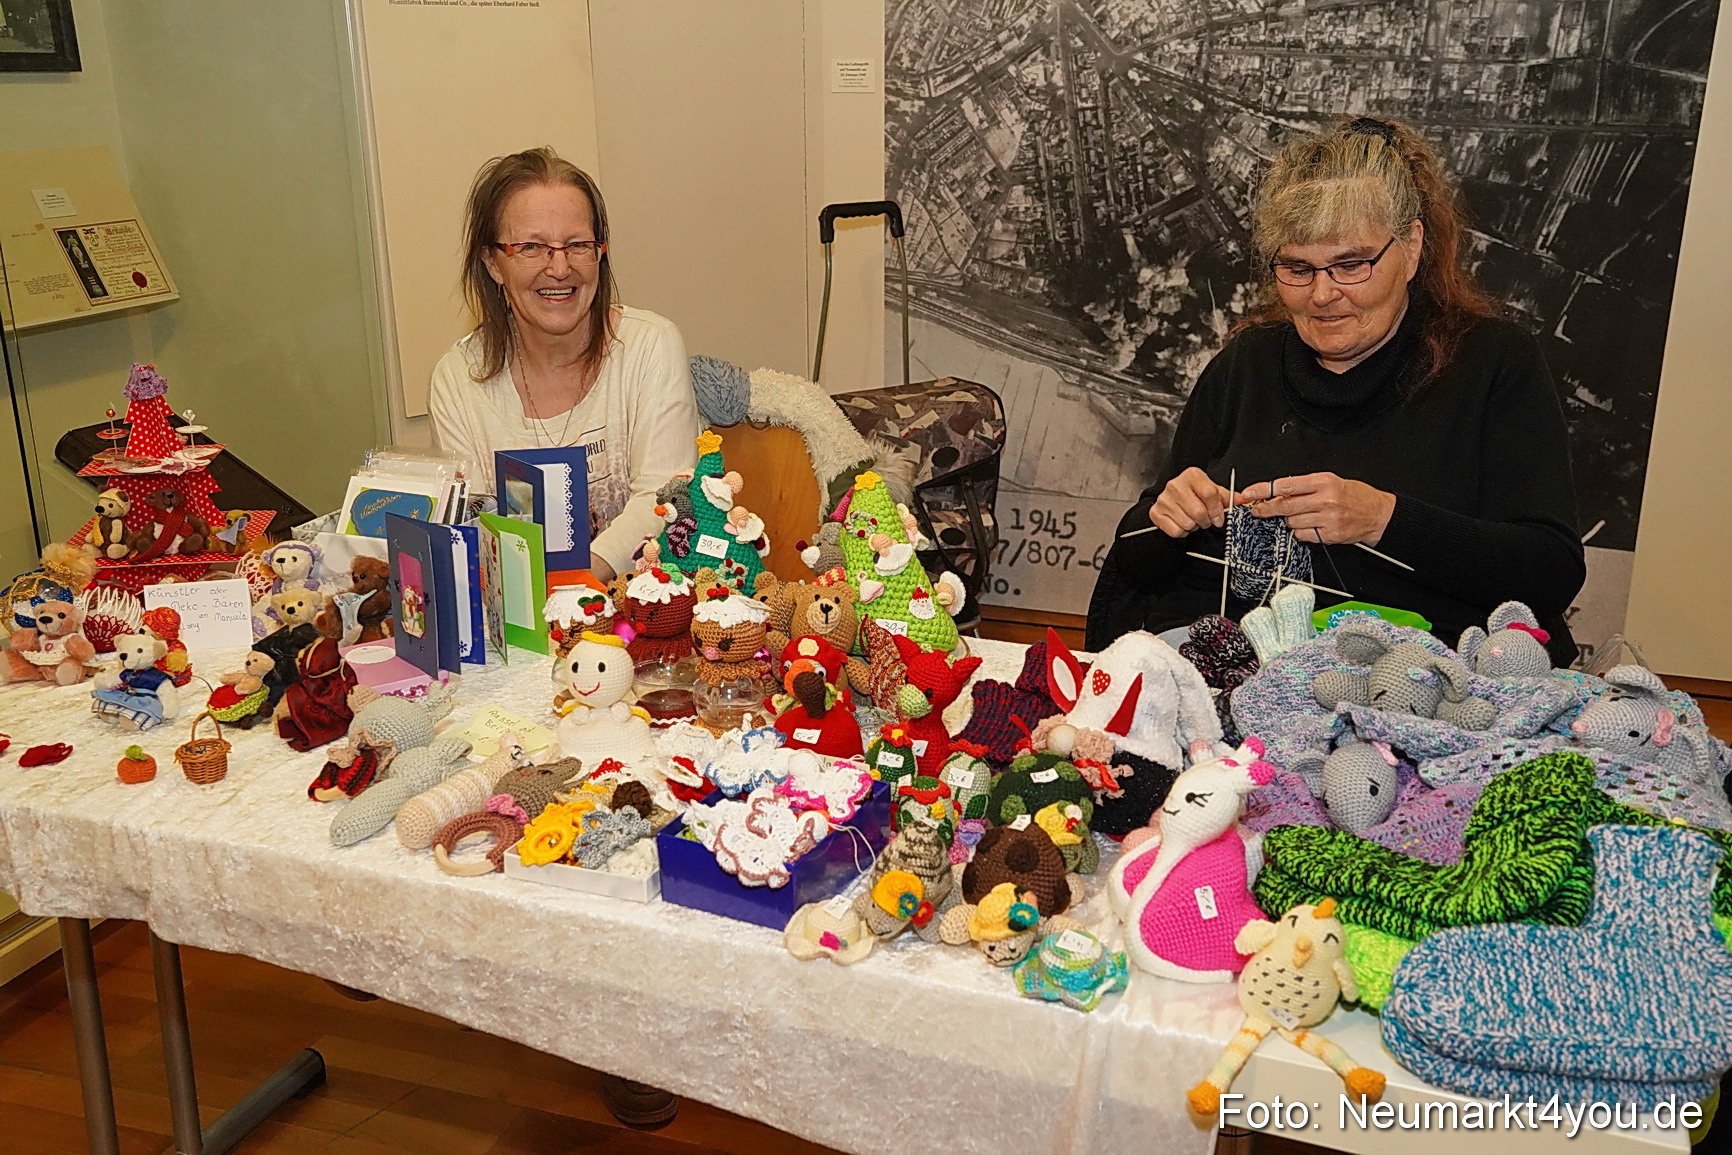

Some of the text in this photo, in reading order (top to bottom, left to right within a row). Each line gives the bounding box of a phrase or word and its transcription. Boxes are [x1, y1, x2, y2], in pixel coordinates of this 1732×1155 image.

[1010, 507, 1077, 539] 1945
[147, 586, 228, 598] Künstler oder
[212, 596, 244, 608] Bären
[214, 611, 248, 622] Manuela
[488, 709, 521, 727] Rassel
